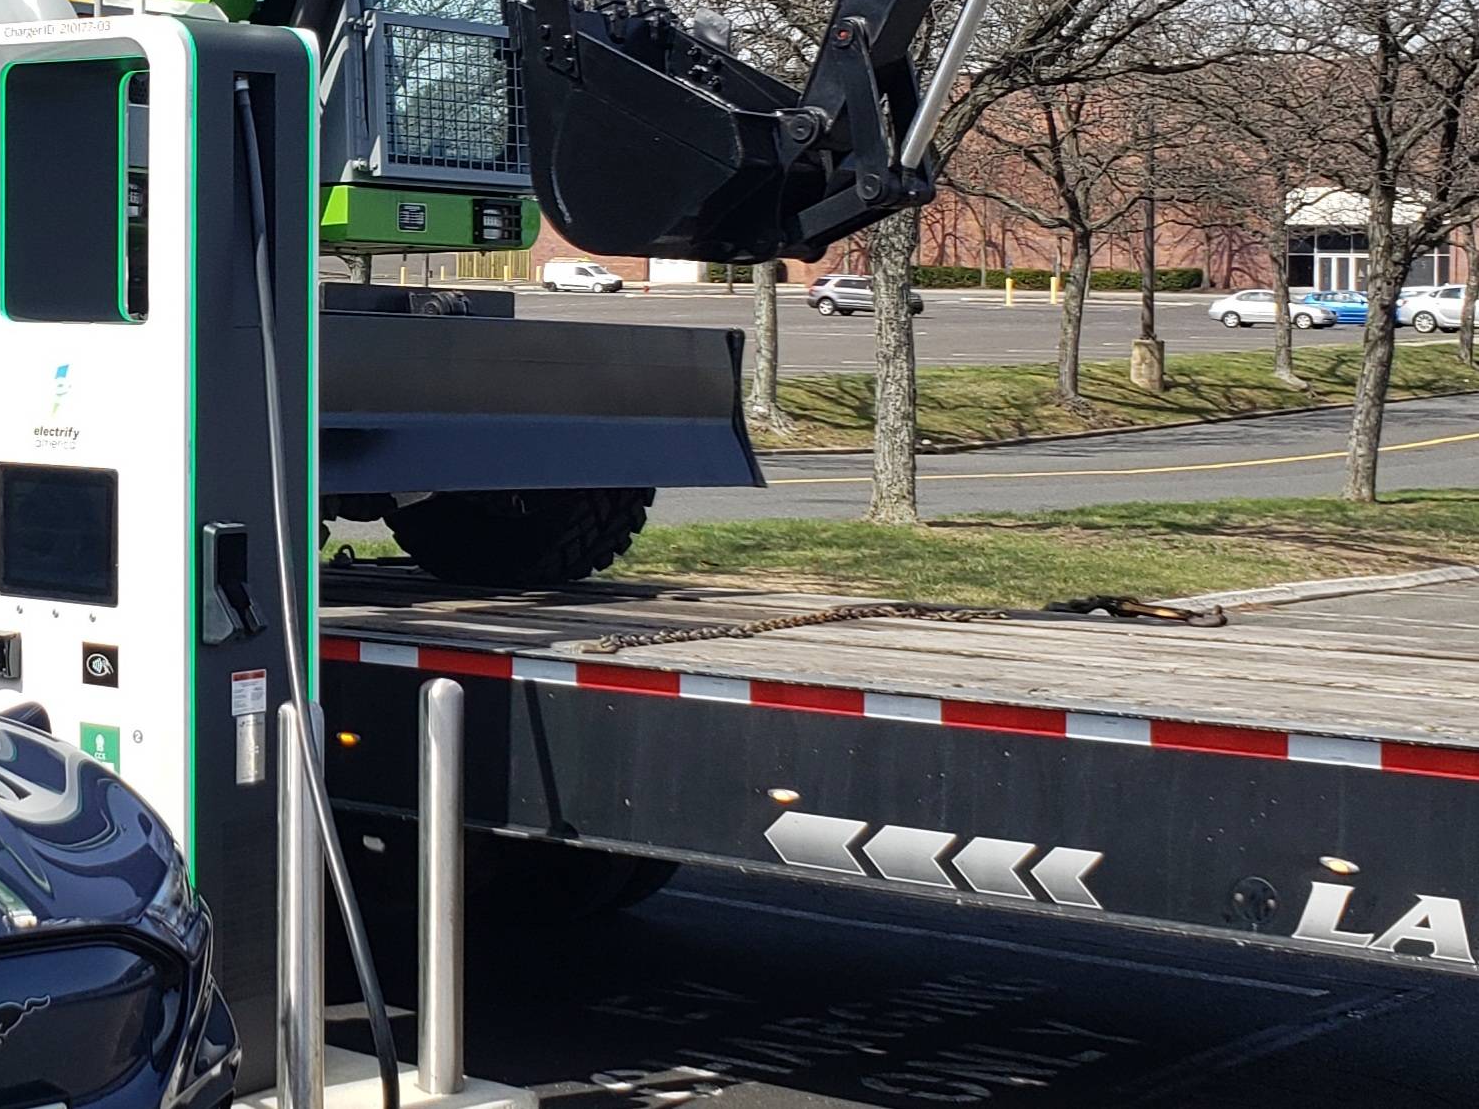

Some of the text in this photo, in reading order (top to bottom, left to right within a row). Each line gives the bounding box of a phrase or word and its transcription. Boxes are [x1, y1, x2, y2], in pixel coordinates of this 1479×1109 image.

[4, 27, 41, 39] Charger
[34, 426, 80, 440] electrify
[858, 1017, 1143, 1103] ONLY
